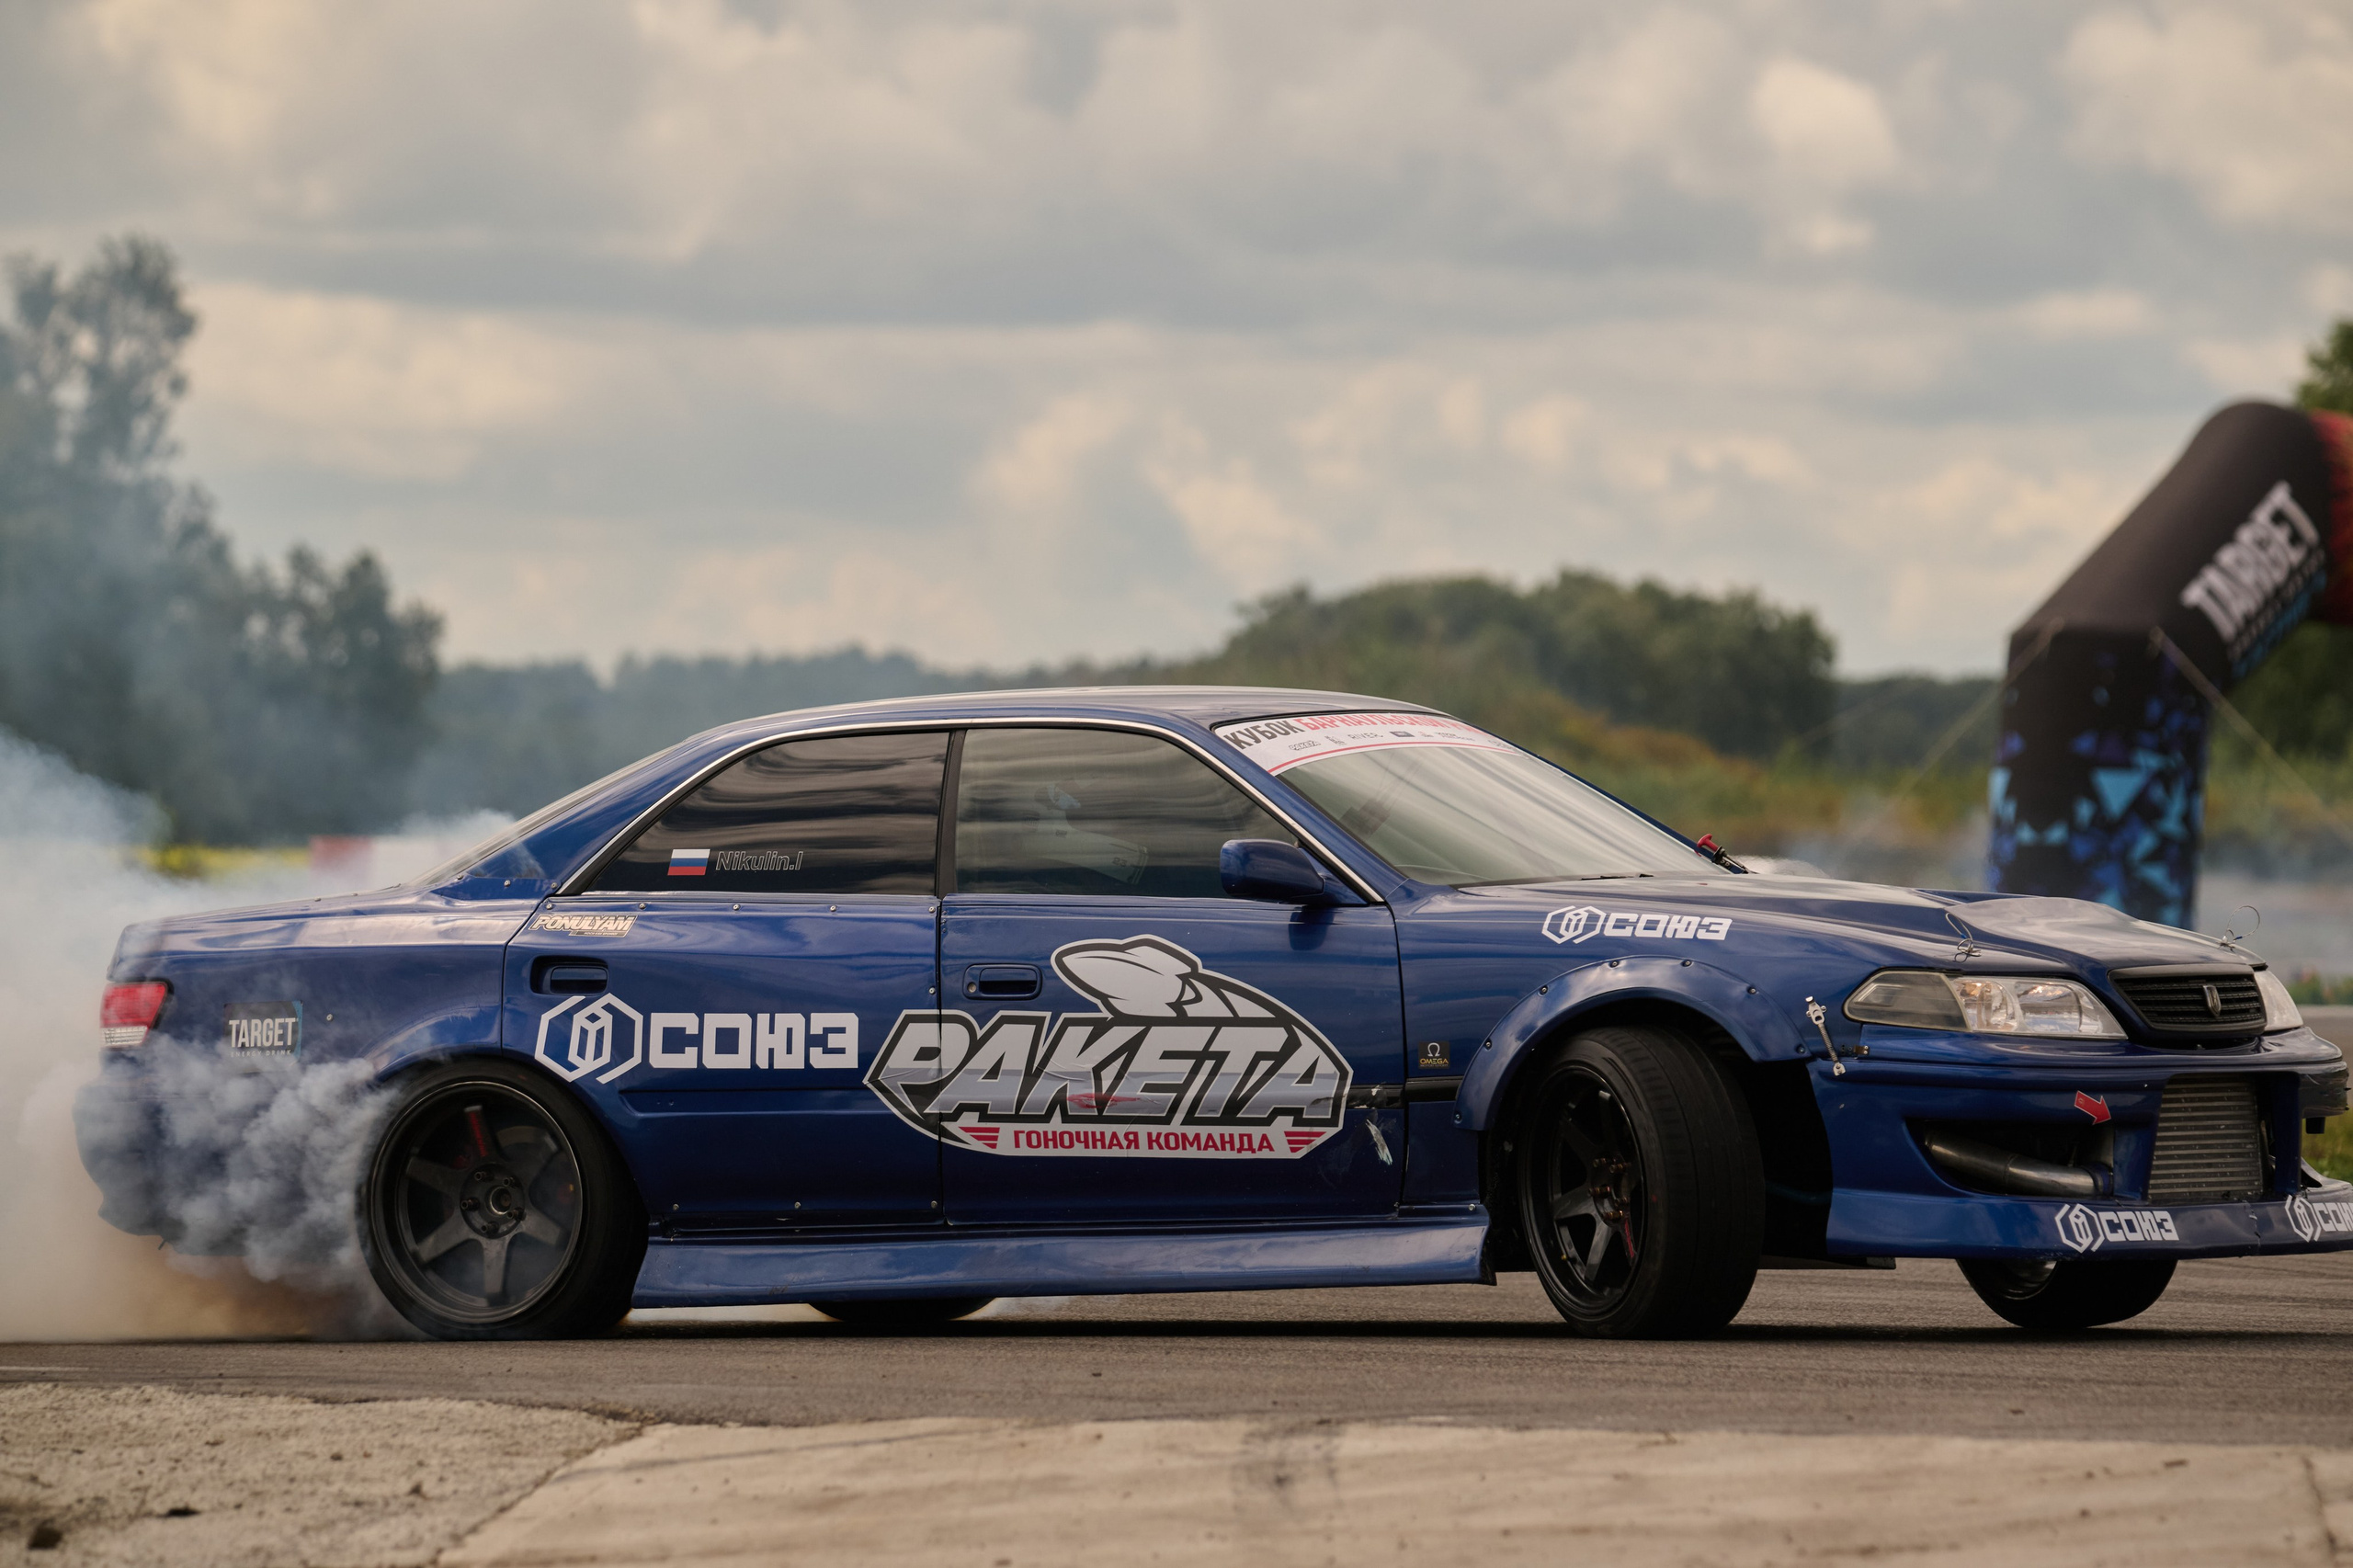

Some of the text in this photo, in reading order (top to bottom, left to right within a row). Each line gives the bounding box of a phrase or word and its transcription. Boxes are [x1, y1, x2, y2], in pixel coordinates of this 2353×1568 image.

[2179, 479, 2321, 642] TARGET
[1222, 720, 1306, 750] КУБОК
[530, 915, 637, 932] PONULYAM
[1603, 912, 1733, 941] СОЮЗ
[228, 1017, 296, 1048] TARGET
[649, 1012, 859, 1069] СОЮЗ
[876, 1011, 1345, 1123] РАКЕТА
[1013, 1130, 1275, 1154] ГОНОЧНАЯ КОМАНДА
[2097, 1210, 2179, 1242] СОЮЗ
